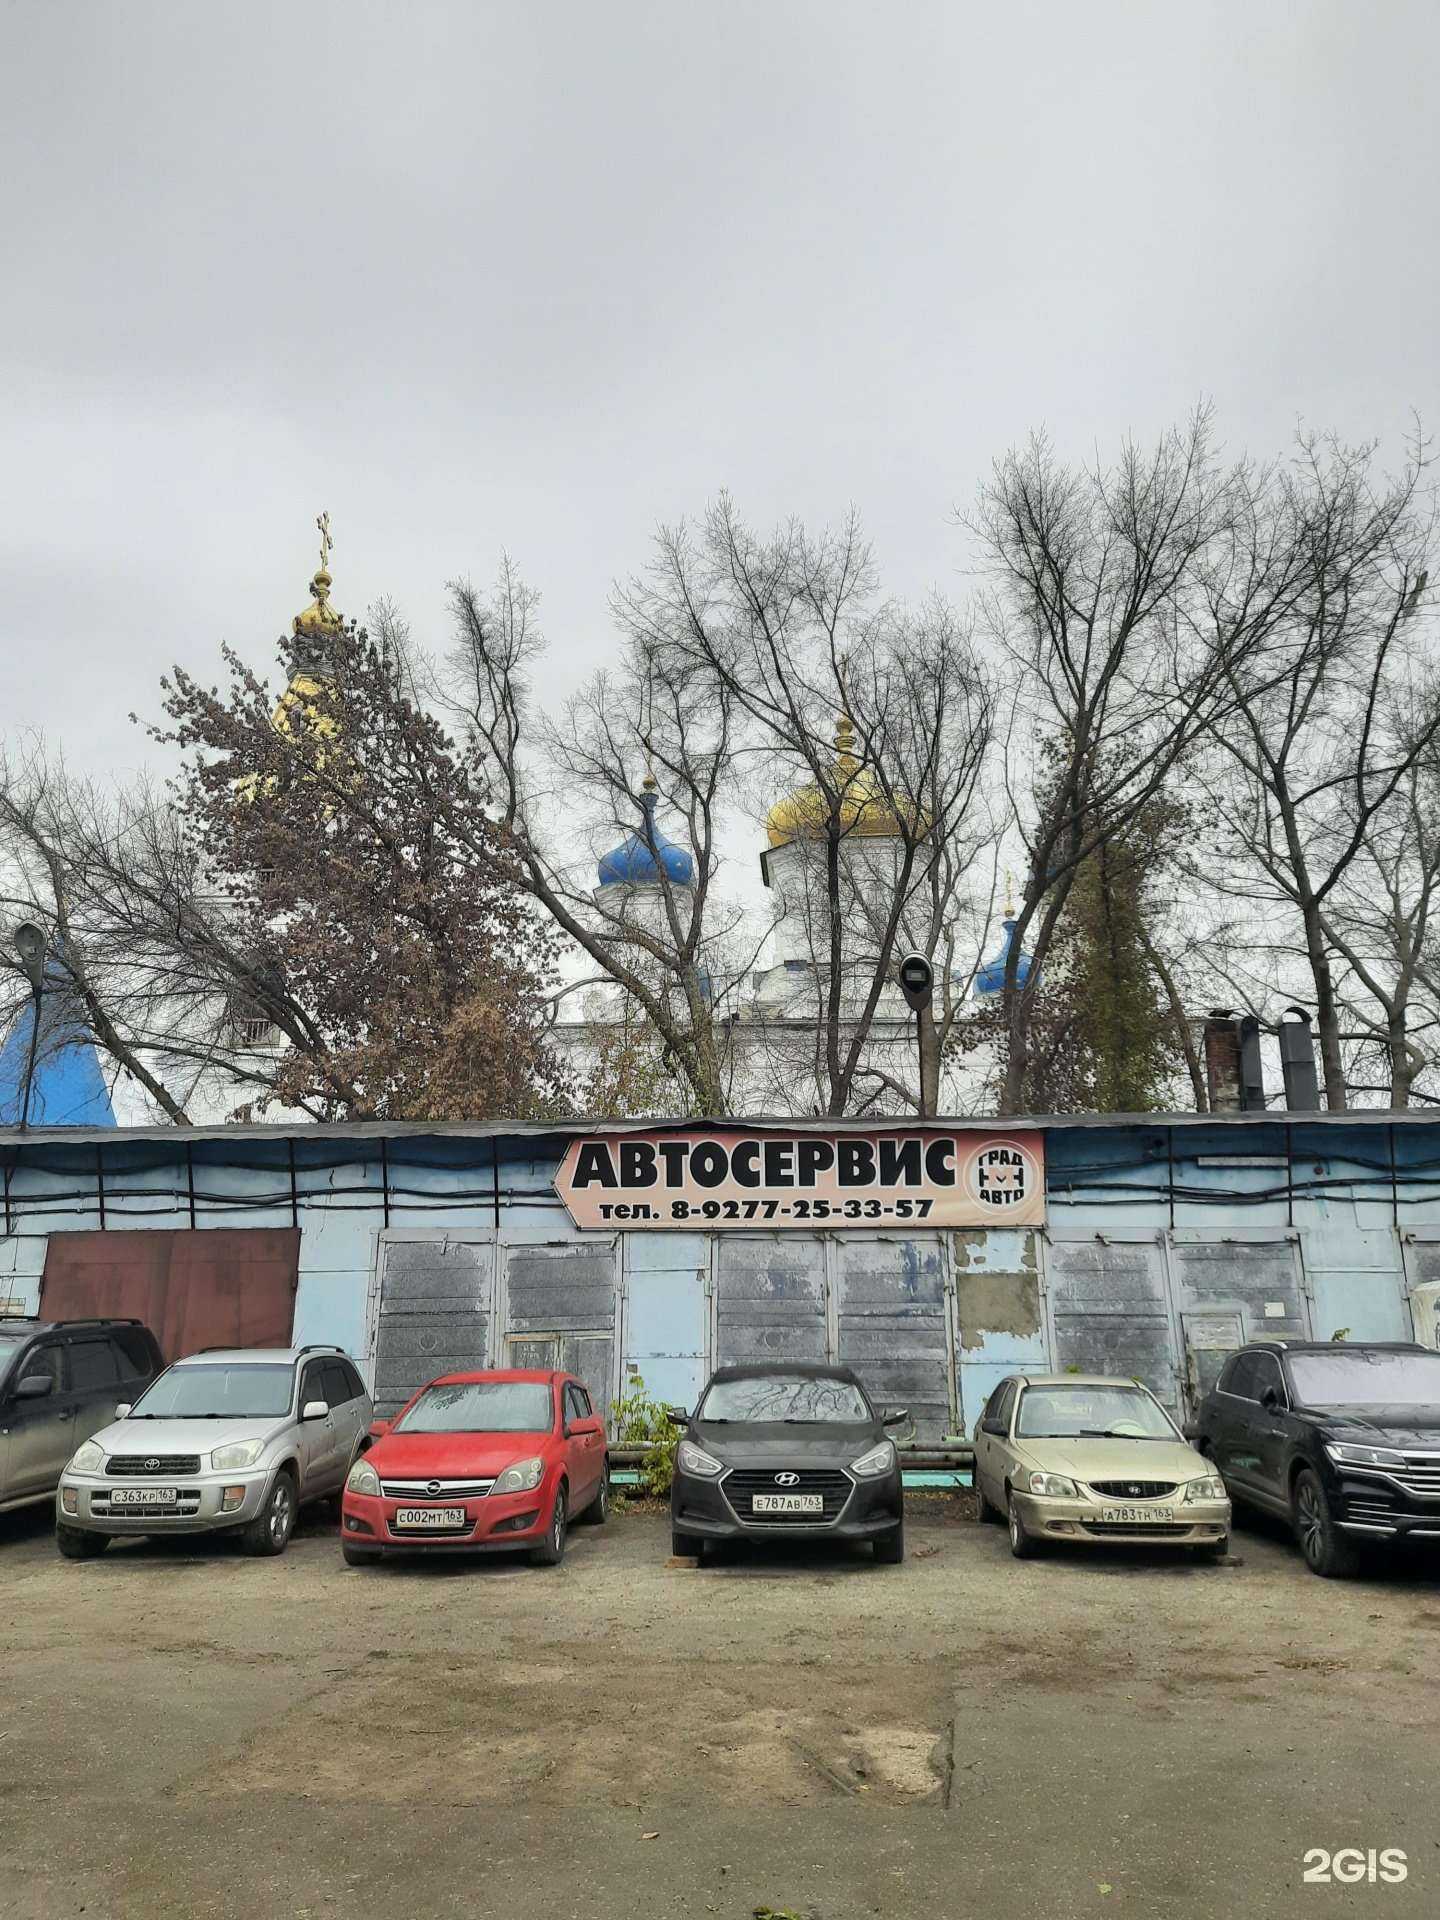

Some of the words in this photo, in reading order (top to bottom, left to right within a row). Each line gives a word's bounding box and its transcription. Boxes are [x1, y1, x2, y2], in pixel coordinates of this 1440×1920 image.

[571, 1139, 957, 1188] АВТОСЕРВИС
[978, 1149, 1024, 1166] ГРАД
[979, 1188, 1025, 1205] АВТО
[599, 1203, 660, 1220] тел.
[671, 1199, 934, 1219] 8-9277-25-33-57
